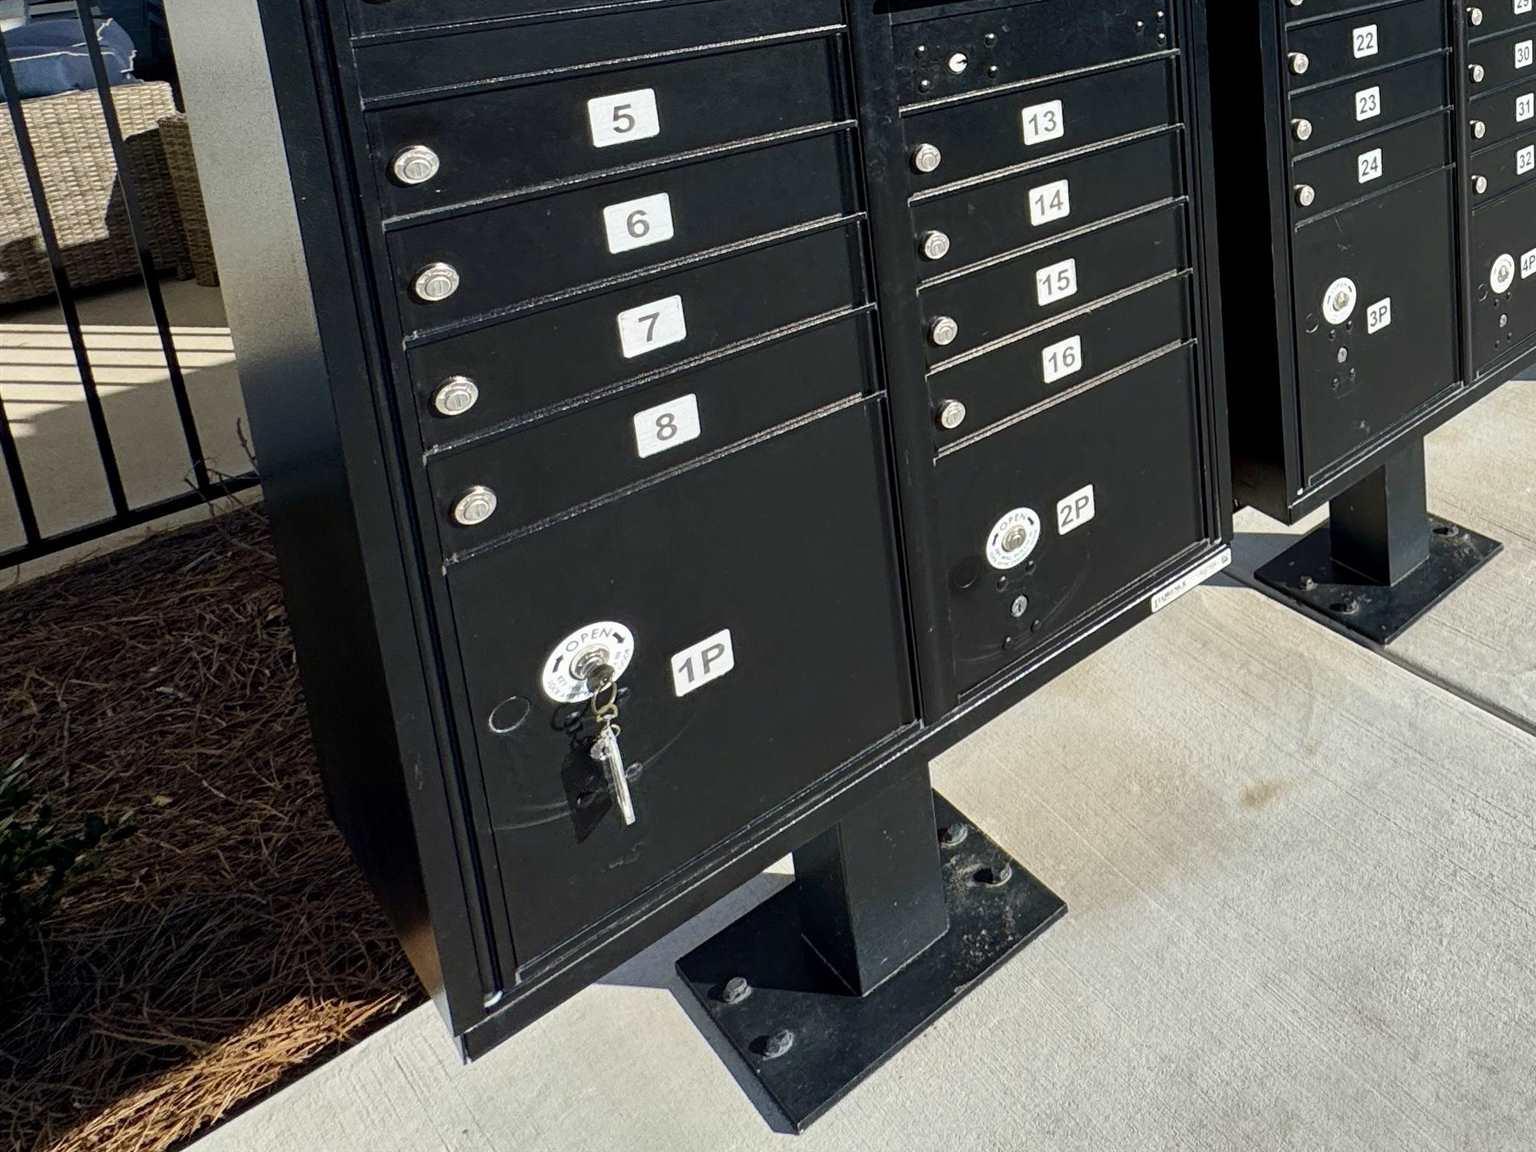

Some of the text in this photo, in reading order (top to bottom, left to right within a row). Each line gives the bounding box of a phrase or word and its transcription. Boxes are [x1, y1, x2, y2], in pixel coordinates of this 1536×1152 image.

[1356, 32, 1374, 52] 22
[1517, 46, 1530, 63] 30
[1359, 94, 1377, 115] 23
[1519, 99, 1530, 117] 31
[612, 103, 635, 134] 5
[1028, 110, 1057, 136] 13
[1361, 156, 1379, 177] 24
[1519, 151, 1532, 169] 32
[1034, 189, 1064, 216] 14
[626, 209, 650, 239] 6
[1522, 254, 1536, 271] 4P
[1043, 268, 1070, 296] 15
[637, 311, 660, 343] 7
[1370, 305, 1388, 327] 3P
[1048, 346, 1076, 373] 16
[655, 413, 678, 441] 8
[1060, 495, 1090, 528] 2P
[565, 627, 613, 652] OPEN
[678, 643, 725, 683] 1P
